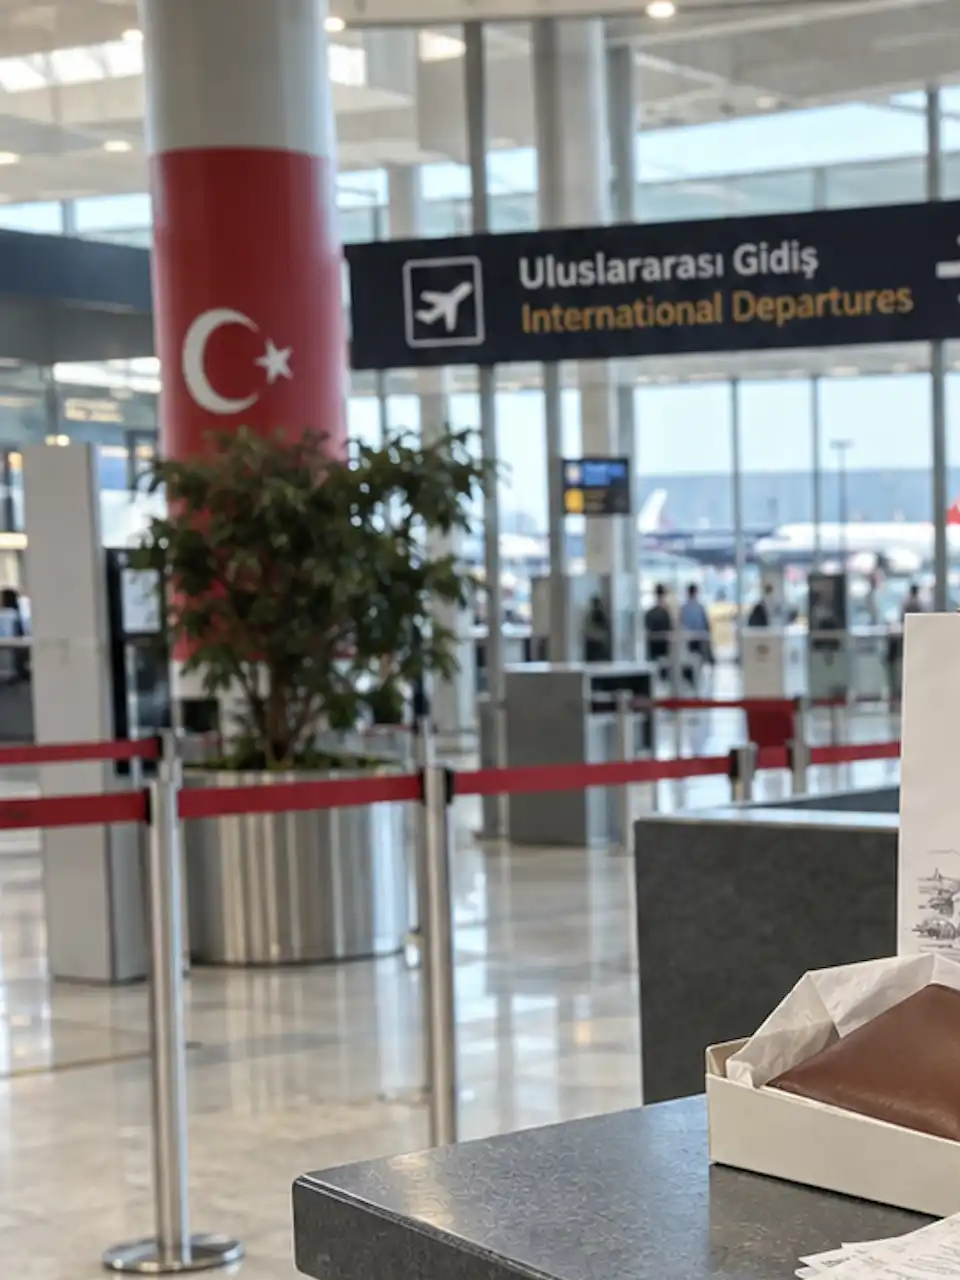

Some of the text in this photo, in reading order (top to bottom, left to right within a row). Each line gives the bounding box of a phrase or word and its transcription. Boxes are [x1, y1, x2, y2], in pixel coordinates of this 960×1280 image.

[519, 240, 819, 289] Uluslararası Gidiş
[521, 286, 914, 334] International Departures
